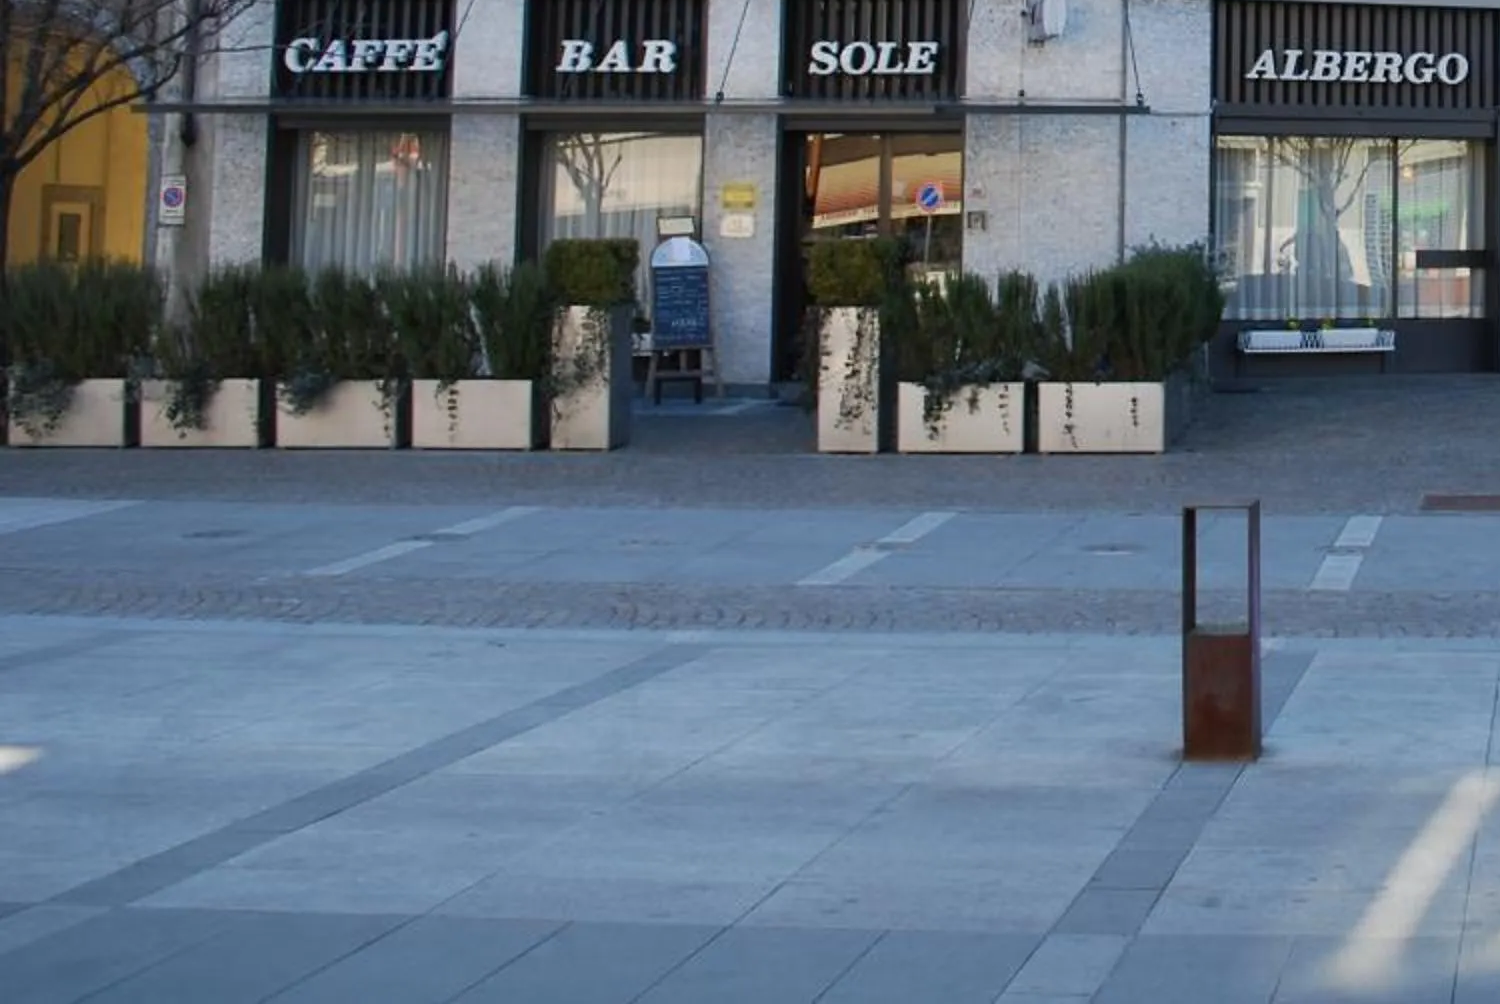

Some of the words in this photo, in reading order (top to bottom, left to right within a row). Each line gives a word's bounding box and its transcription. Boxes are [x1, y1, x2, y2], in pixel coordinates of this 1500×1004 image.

[555, 39, 677, 73] BAR
[808, 40, 939, 75] SOLE
[1246, 49, 1469, 85] ALBERGO
